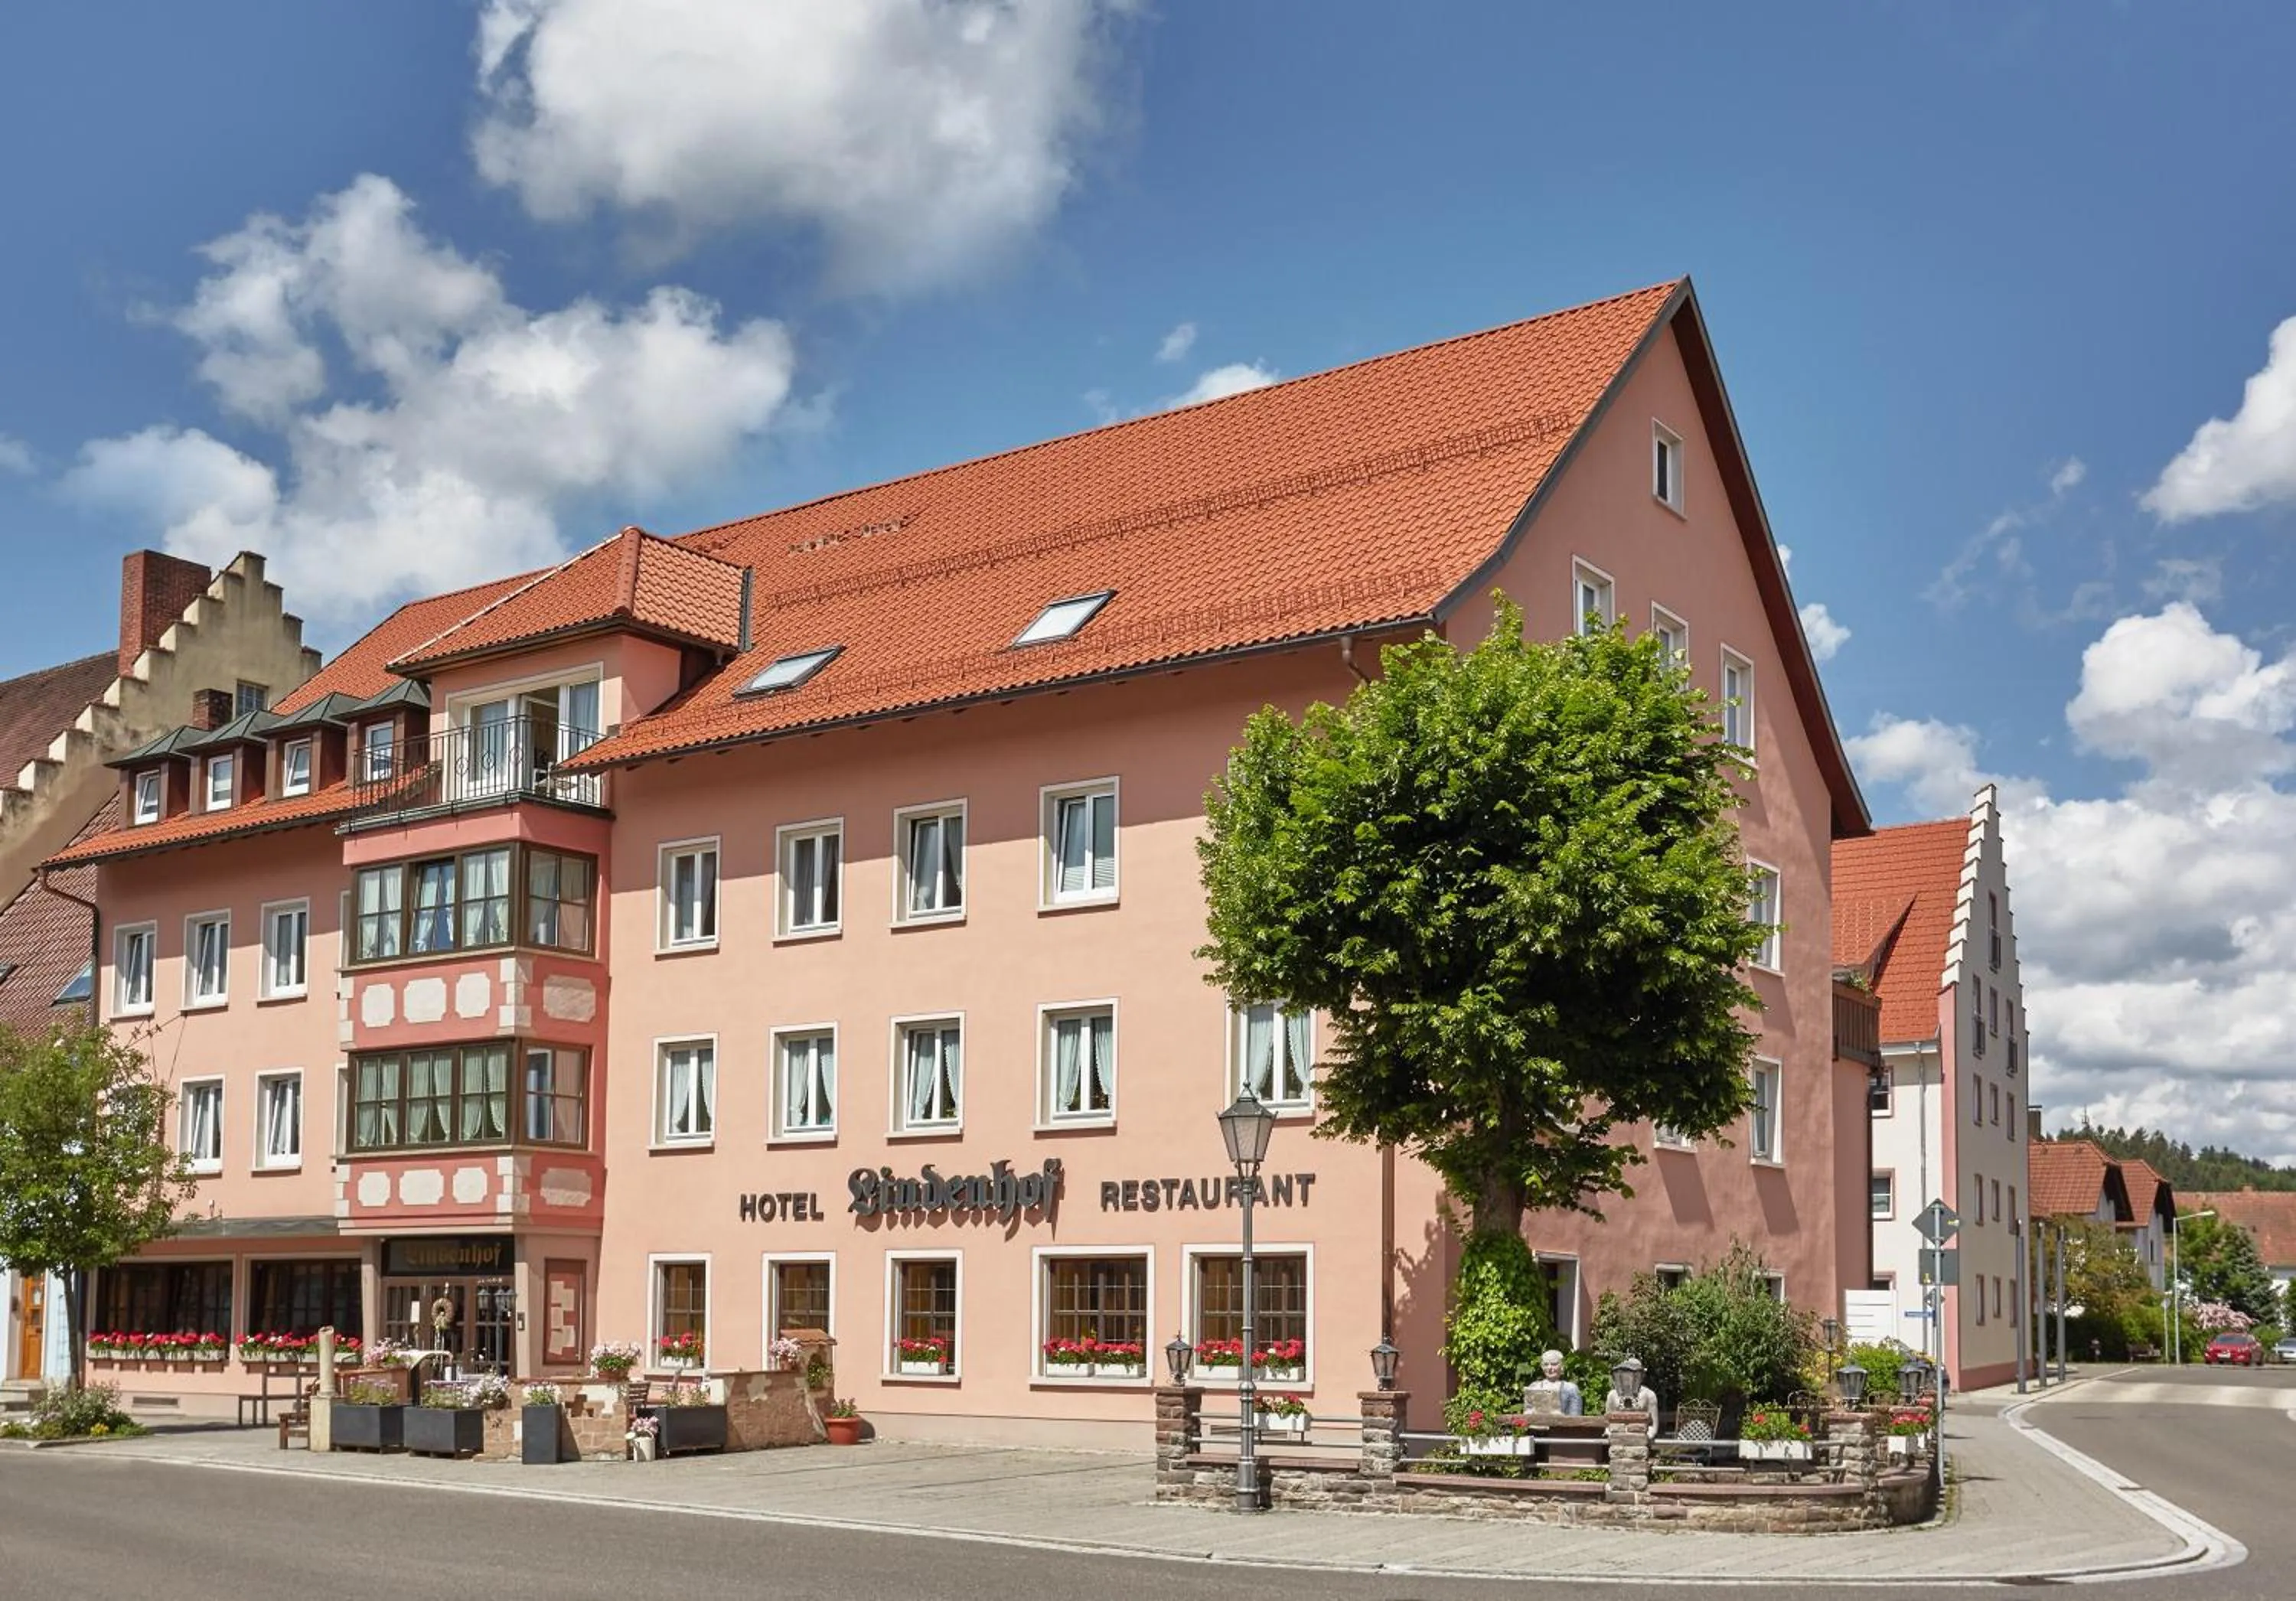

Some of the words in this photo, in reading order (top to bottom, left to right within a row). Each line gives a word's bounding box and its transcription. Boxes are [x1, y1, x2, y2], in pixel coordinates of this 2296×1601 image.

[740, 1192, 824, 1223] HOTEL
[847, 1158, 1063, 1224] Lindenhof
[1101, 1173, 1316, 1212] RESTAURANT
